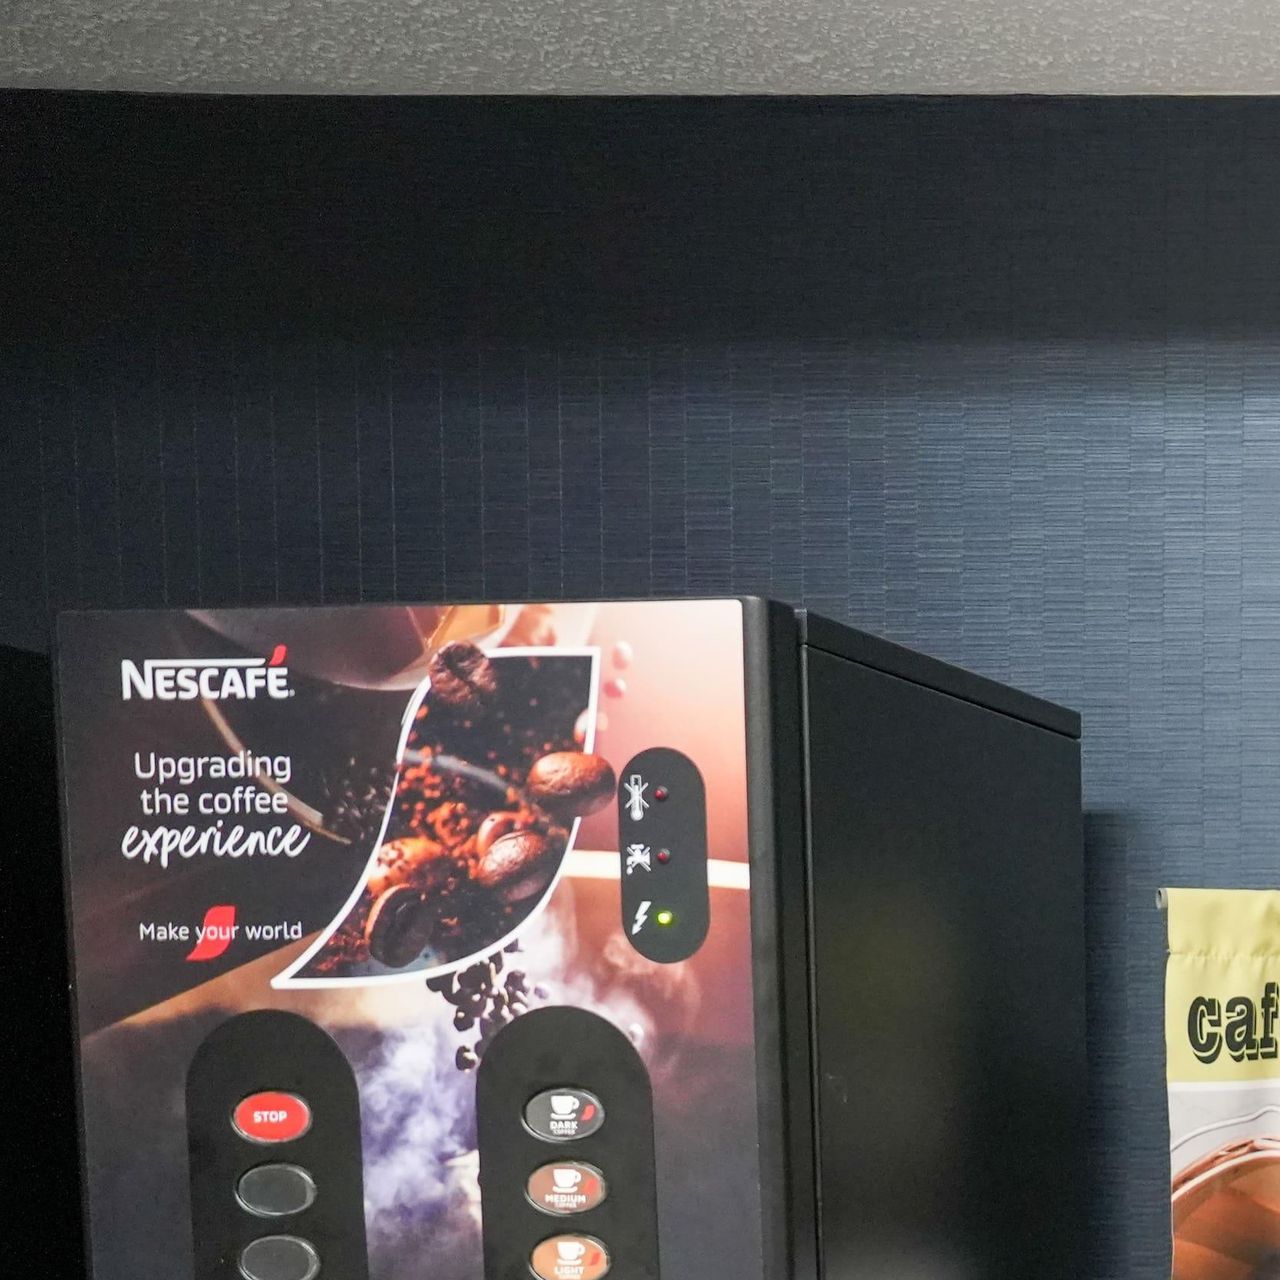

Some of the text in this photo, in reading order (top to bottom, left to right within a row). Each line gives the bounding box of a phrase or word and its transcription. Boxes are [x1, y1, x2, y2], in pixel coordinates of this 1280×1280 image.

[133, 750, 292, 783] Upgrading
[139, 787, 289, 814] the coffee
[121, 822, 311, 869] experience
[139, 920, 303, 946] Make your world
[253, 1111, 288, 1123] STOP
[550, 1121, 578, 1129] DARK
[544, 1194, 587, 1203] MEDIUM
[554, 1266, 584, 1275] LIGHT
